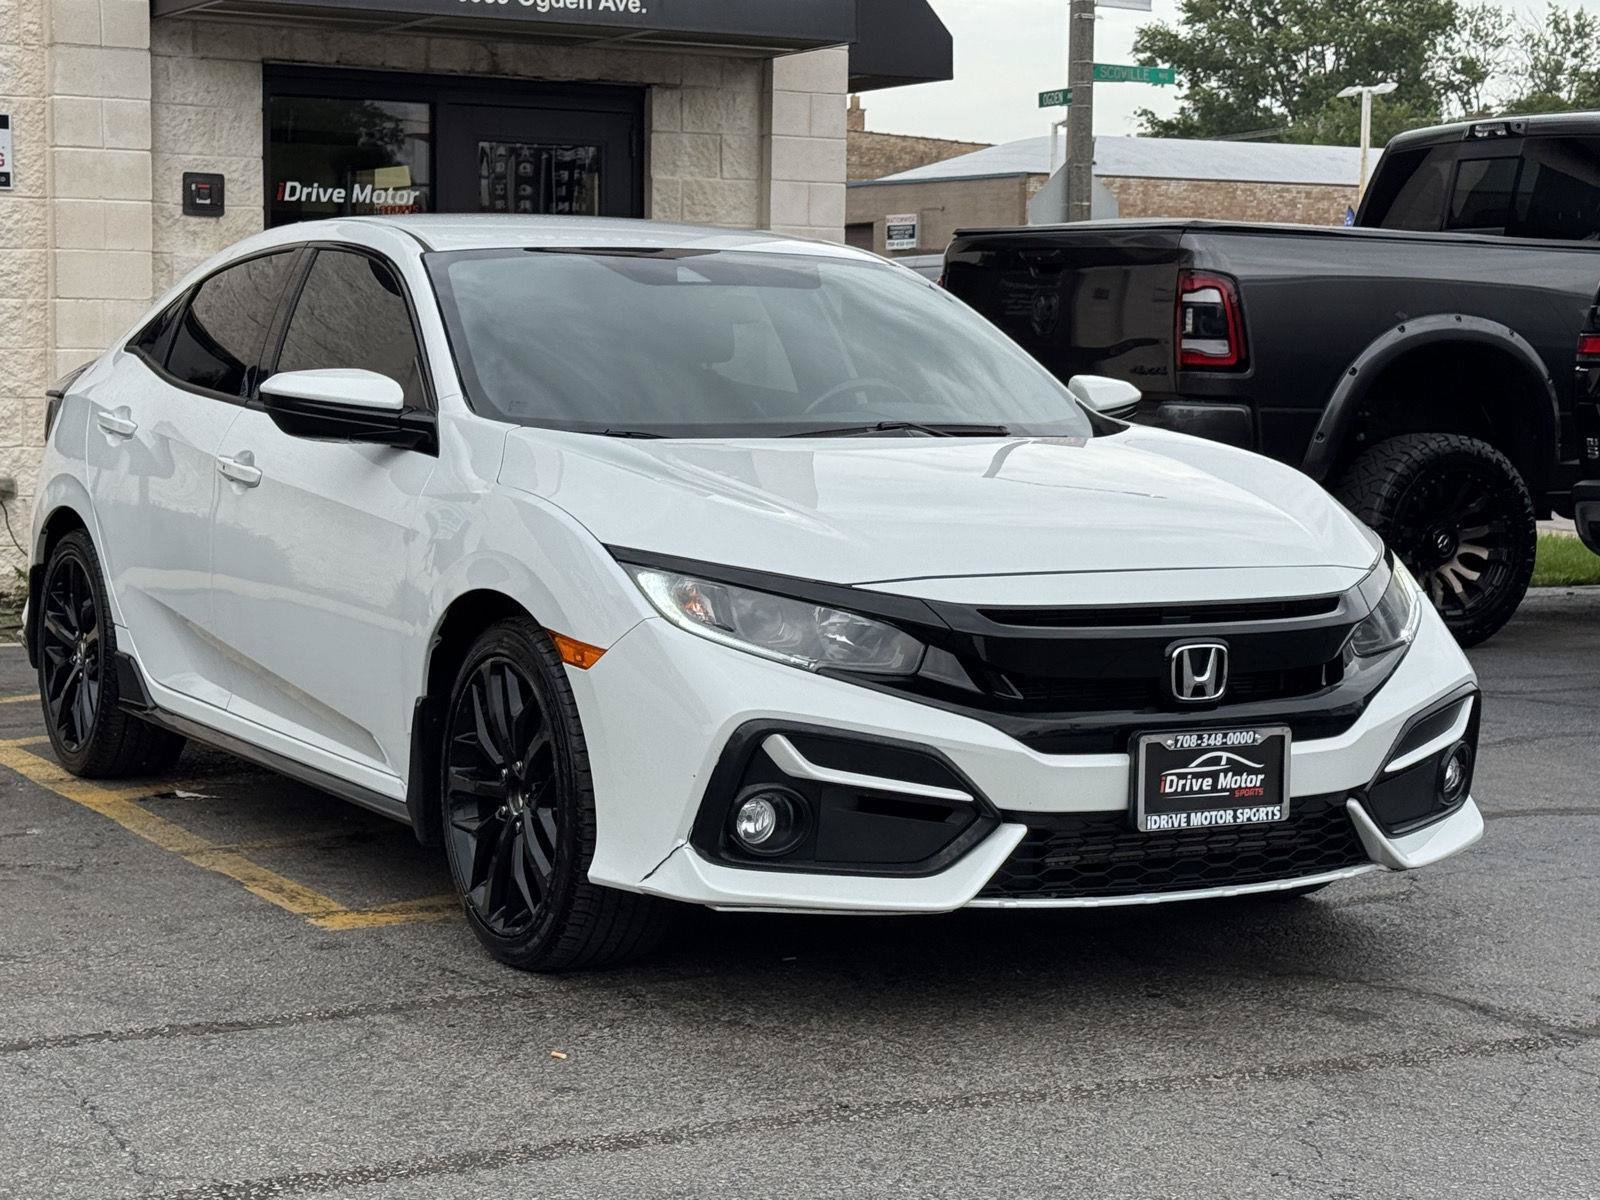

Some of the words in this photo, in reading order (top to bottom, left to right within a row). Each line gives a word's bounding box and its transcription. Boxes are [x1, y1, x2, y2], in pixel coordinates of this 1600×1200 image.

[1100, 65, 1149, 81] SCOVILLE
[1042, 91, 1064, 106] OGDEN
[276, 181, 346, 204] iDrive
[351, 183, 419, 205] Motor
[1176, 731, 1254, 748] 708-348-0000
[1159, 774, 1212, 793] iDrive
[1217, 772, 1265, 789] Motor
[1234, 787, 1264, 798] SPORTS
[1190, 810, 1234, 826] MOTOR
[1236, 806, 1281, 822] SPORTS
